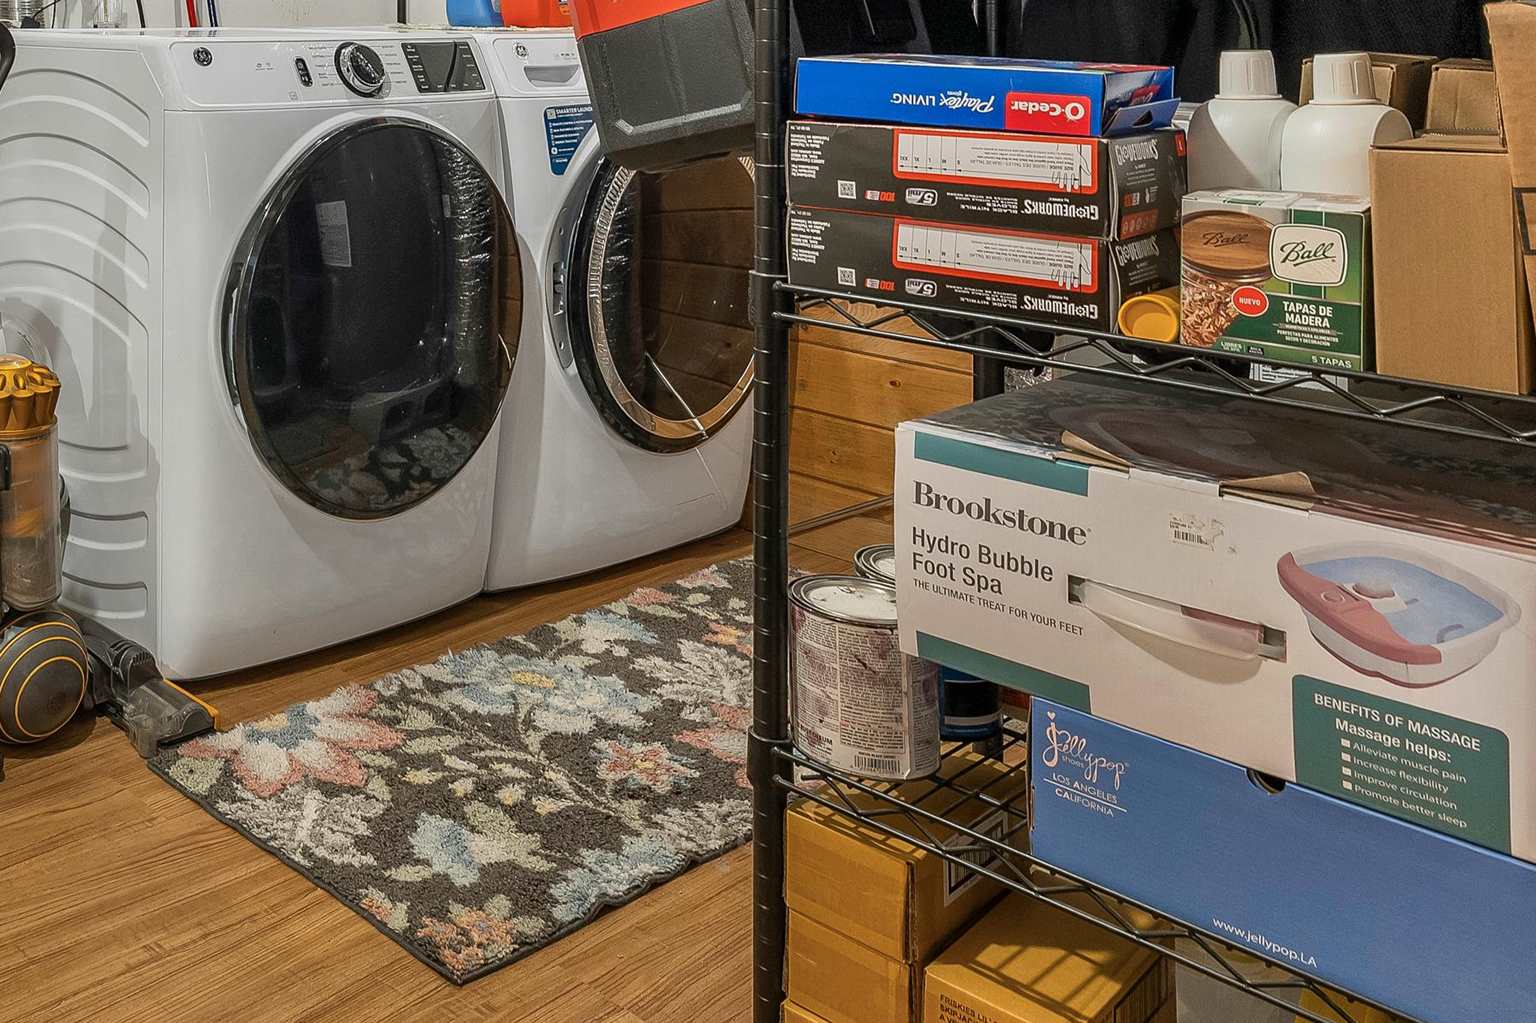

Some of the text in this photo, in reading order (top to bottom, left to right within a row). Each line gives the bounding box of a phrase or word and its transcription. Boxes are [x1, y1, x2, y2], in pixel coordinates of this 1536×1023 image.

[892, 93, 936, 107] LIVING
[939, 94, 995, 114] Playtex
[879, 192, 896, 202] 100
[1202, 232, 1251, 247] Ball
[1279, 241, 1337, 267] Ball
[880, 281, 896, 291] 100
[1239, 297, 1261, 306] NUEVO
[1283, 301, 1333, 317] TAPAS DE
[1285, 313, 1330, 328] MADERA
[1311, 355, 1352, 368] 5 TAPAS
[912, 480, 1087, 545] Brookstone
[912, 526, 1054, 582] Hydro Bubble
[912, 552, 1003, 595] Foot Spa
[913, 578, 1084, 637] THE ULTIMATE TREAT FOR YOUR FEET
[1314, 692, 1482, 752] BENEFITS OF MASSAGE
[1335, 717, 1452, 763] Massage helps:
[1353, 742, 1467, 784] Alleviate muscle pain
[1353, 756, 1449, 794] Increase flexibility
[1052, 772, 1117, 804] LOS ANGELES
[1055, 788, 1114, 817] CALIFORNIA
[1354, 770, 1458, 810] Improve circulation
[1354, 785, 1468, 828] Promote better sleep
[1212, 917, 1318, 969] www.jellypop.LA
